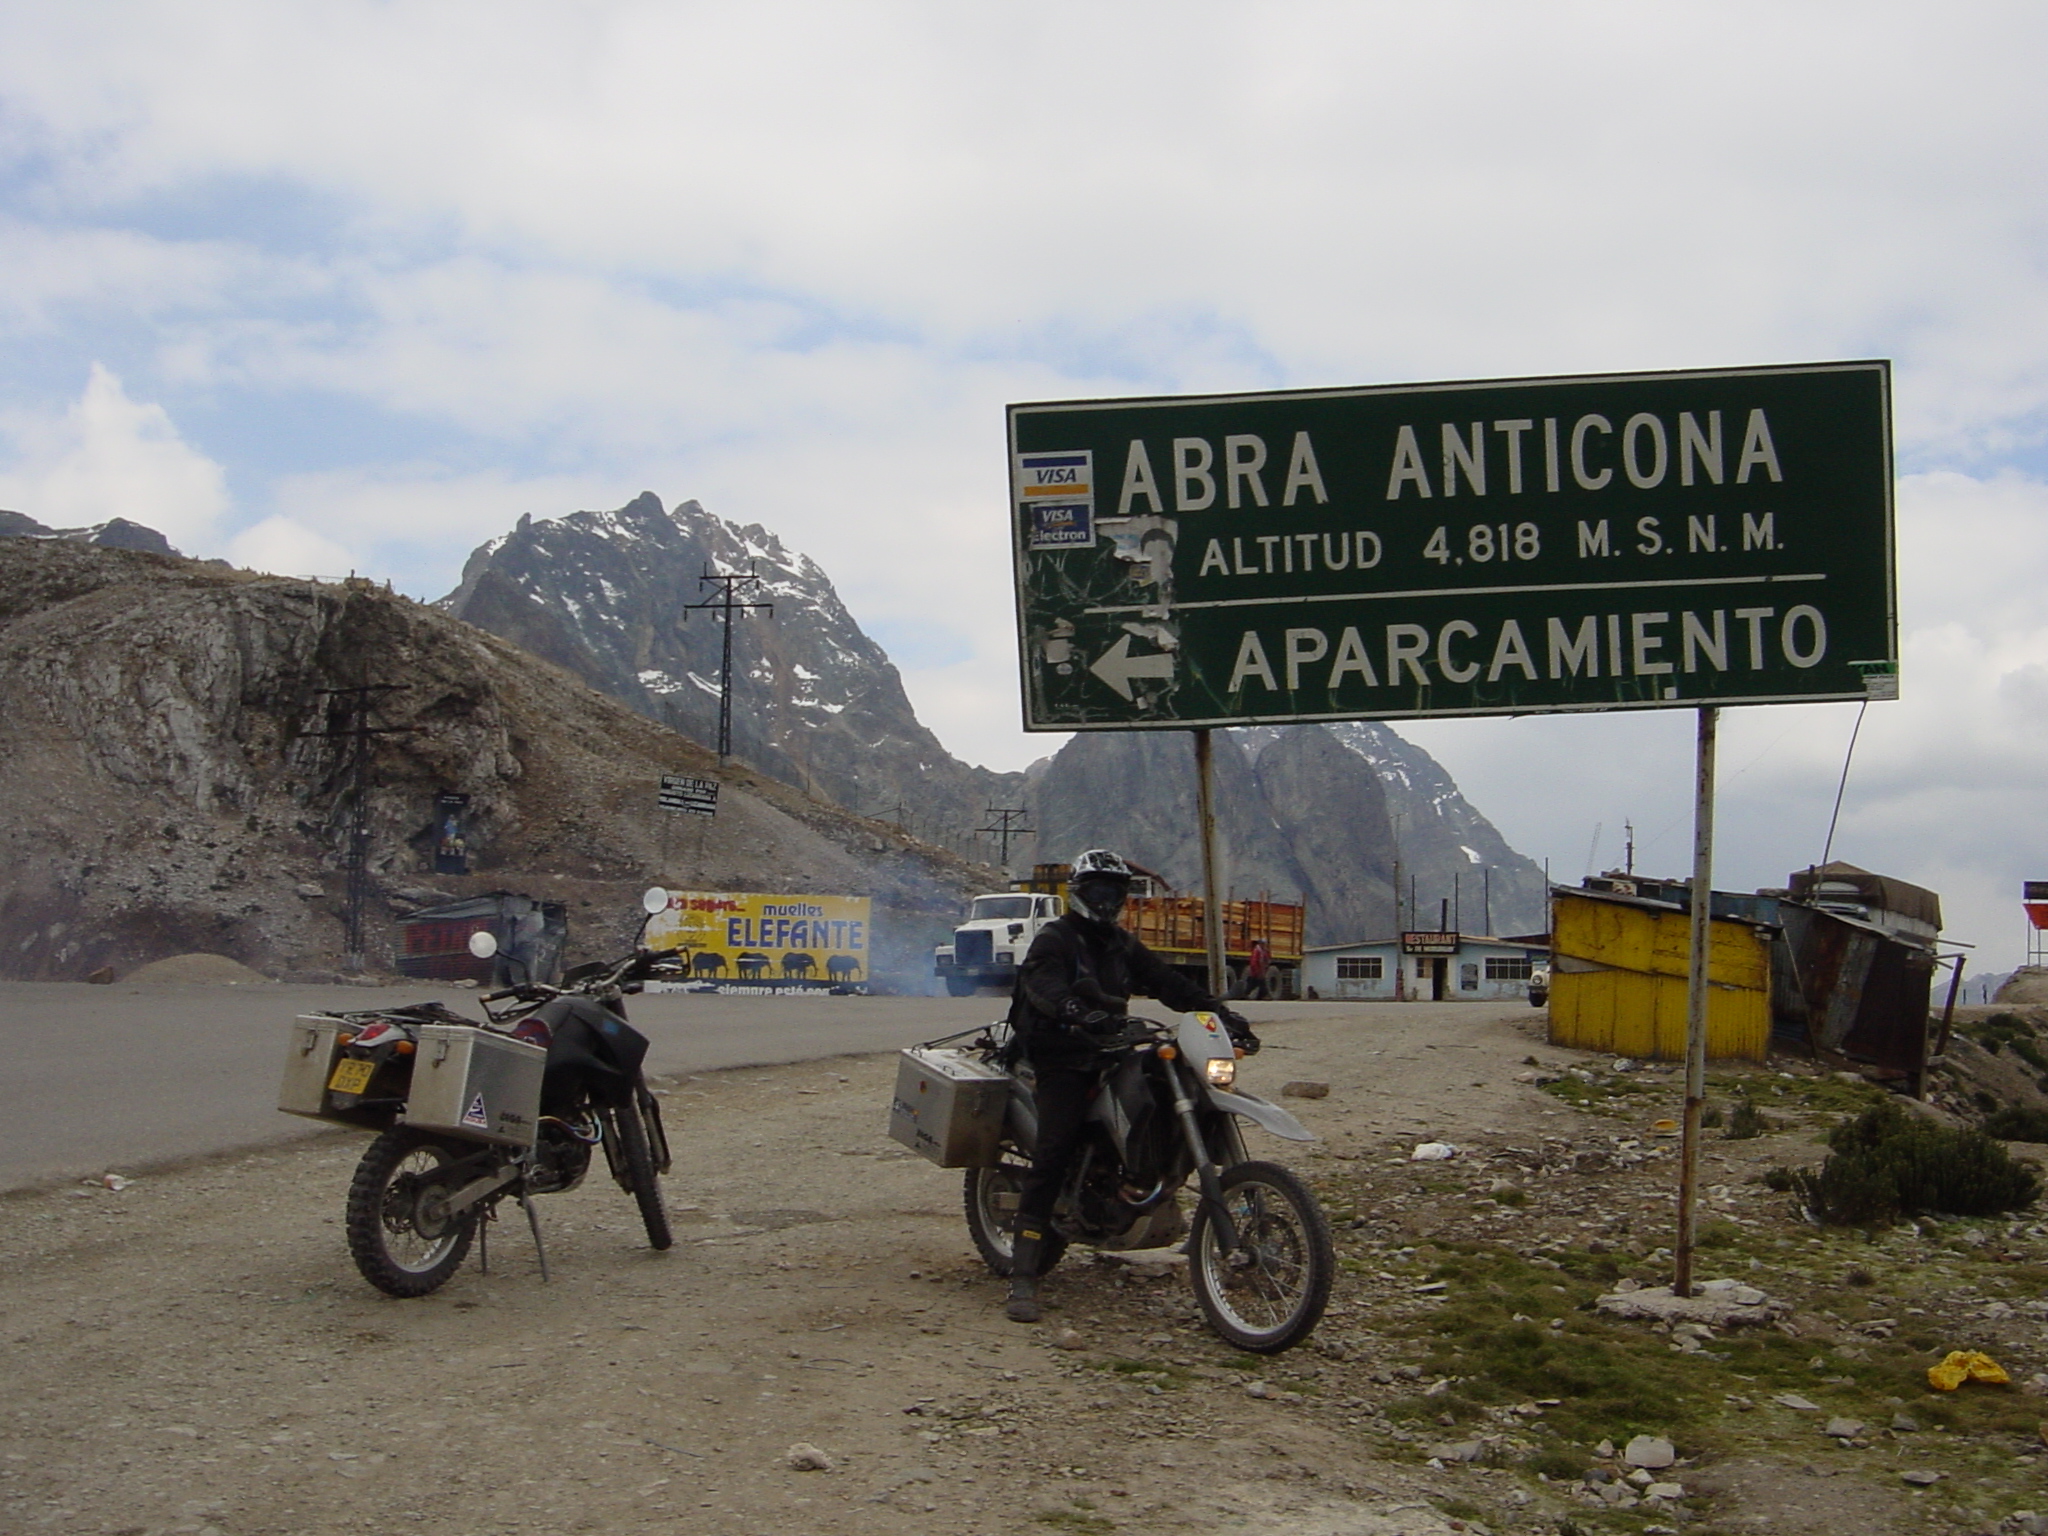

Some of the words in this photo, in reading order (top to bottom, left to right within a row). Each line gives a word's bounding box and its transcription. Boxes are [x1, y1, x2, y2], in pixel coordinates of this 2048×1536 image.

[1036, 468, 1077, 484] VISA
[1119, 431, 1328, 514] ABRA
[1387, 408, 1783, 500] ANTICONA
[1042, 509, 1073, 522] VISA
[1200, 531, 1382, 577] ALTITUD
[1229, 604, 1827, 693] APARCAMIENTO
[763, 903, 823, 917] muelles
[728, 917, 863, 949] ELEFANTE
